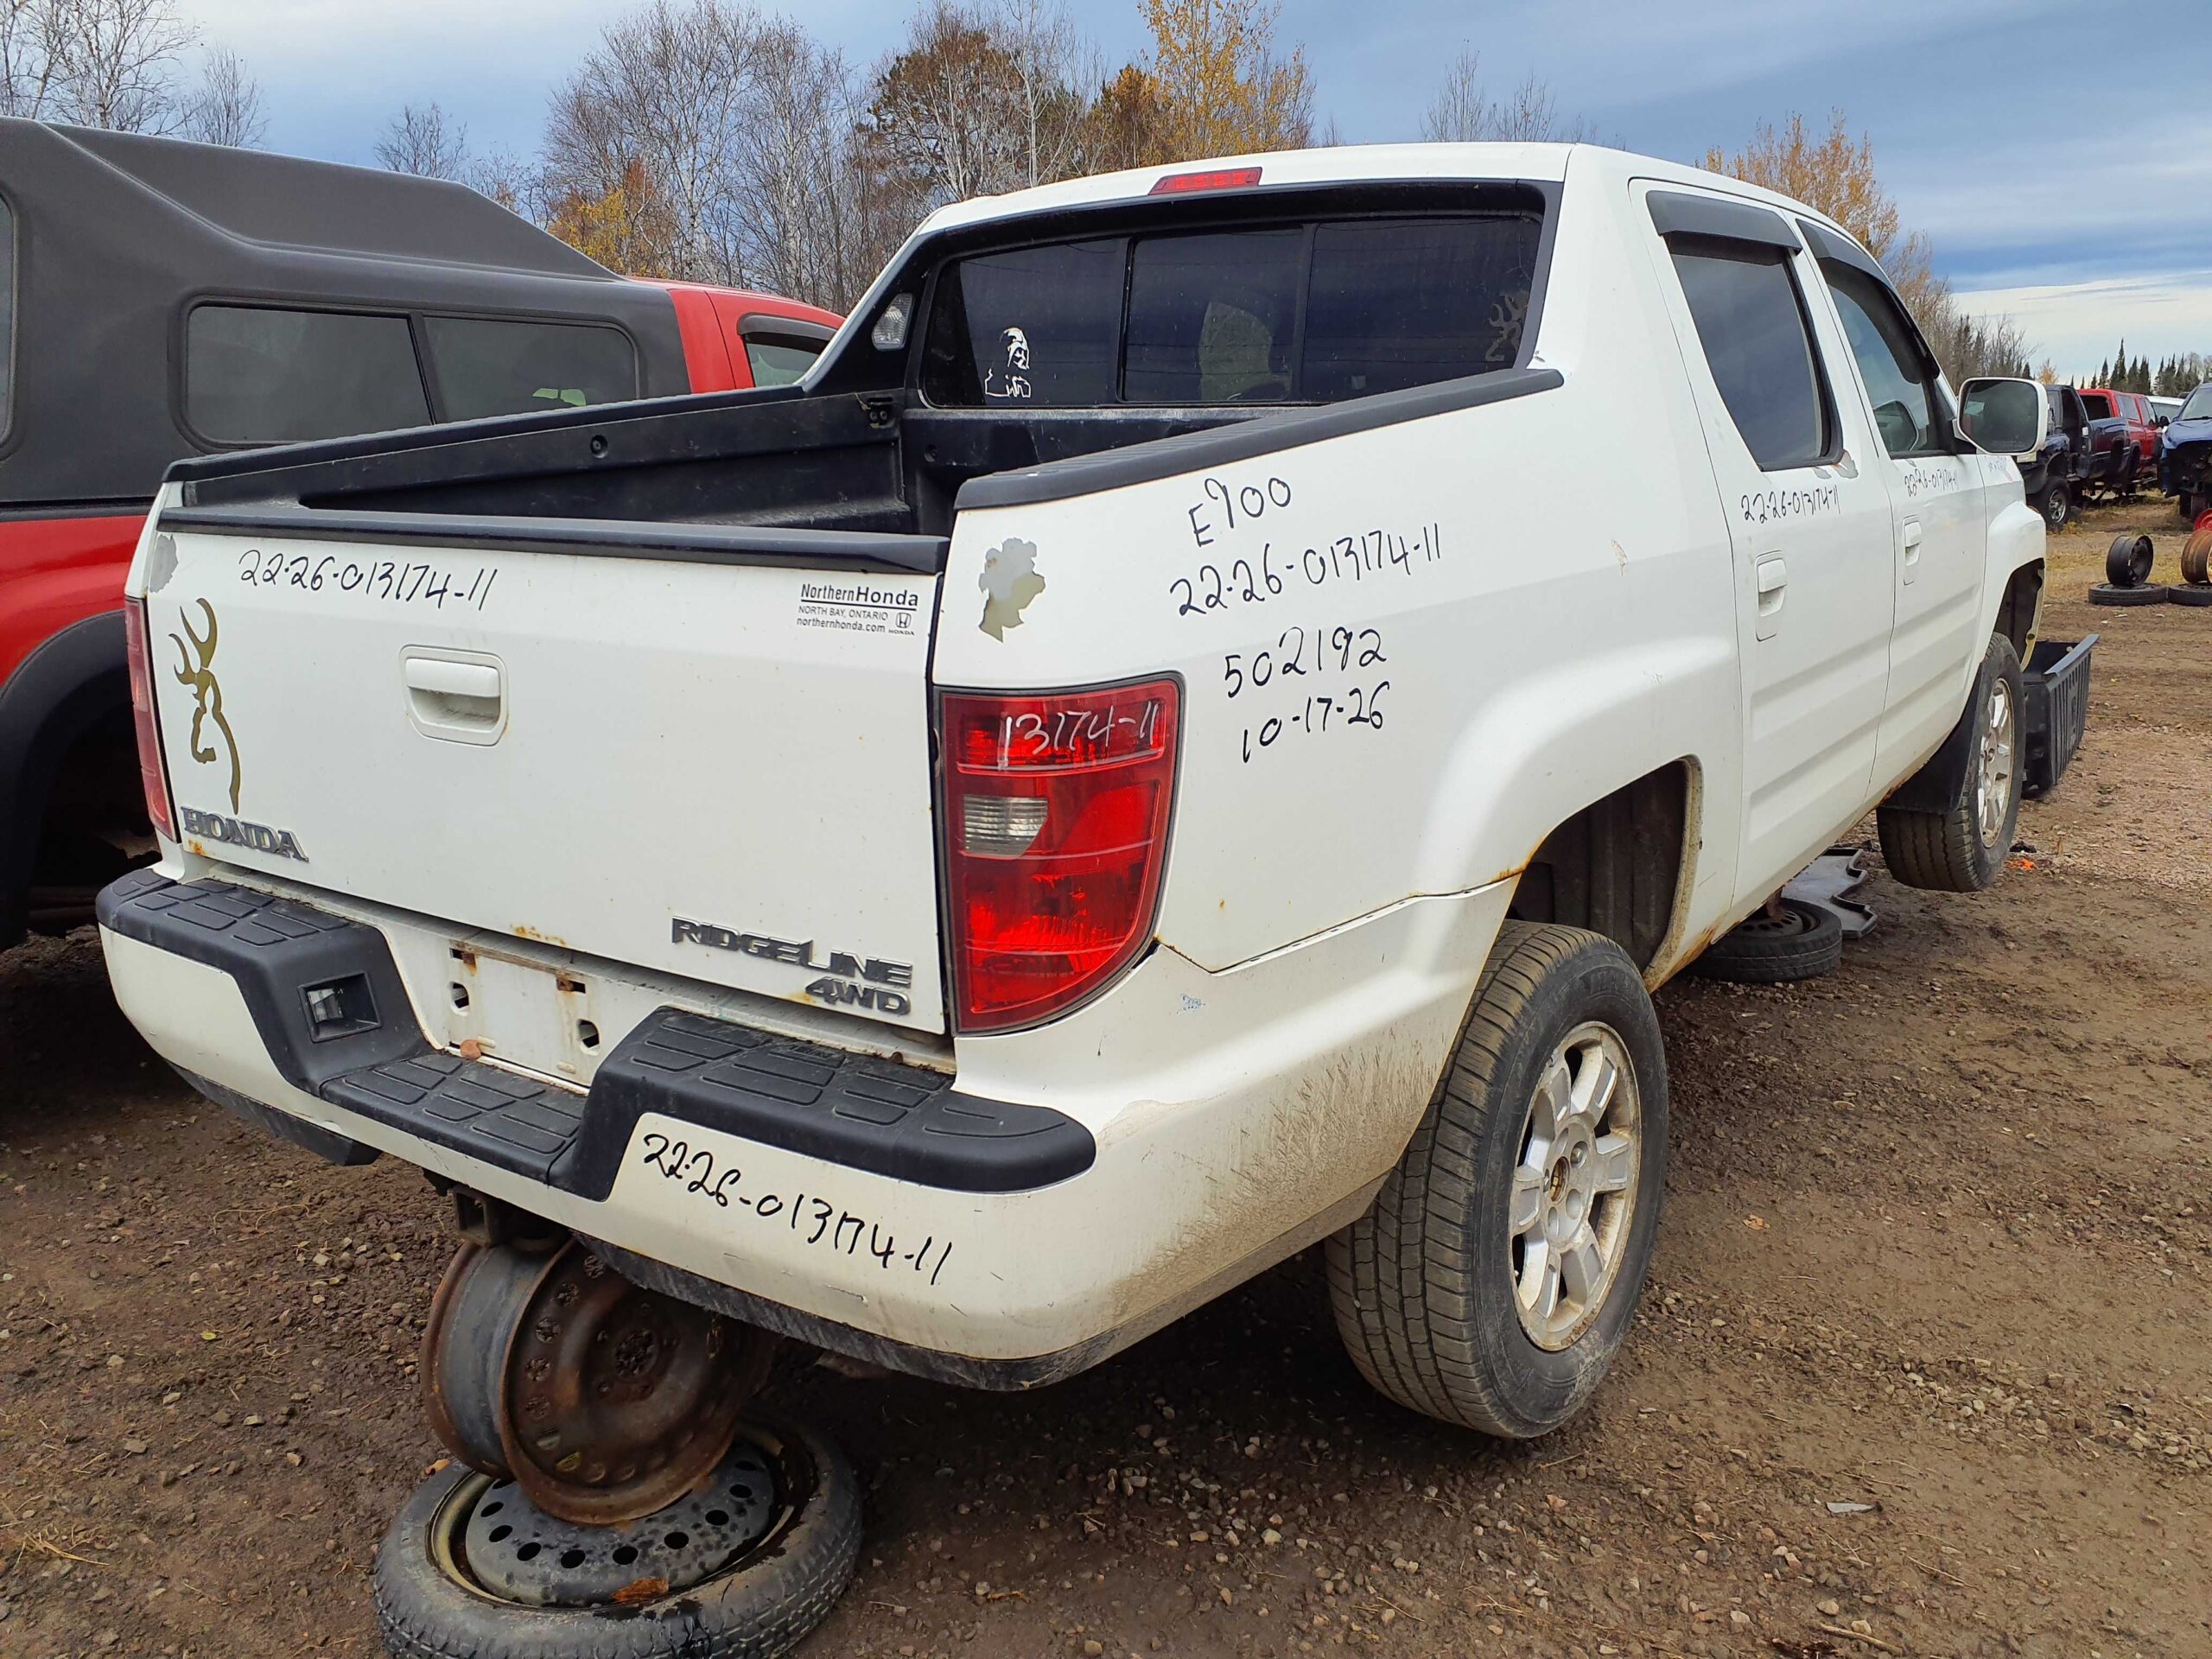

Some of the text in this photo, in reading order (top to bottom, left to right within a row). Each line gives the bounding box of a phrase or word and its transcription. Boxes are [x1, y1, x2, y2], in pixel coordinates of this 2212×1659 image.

[1189, 478, 1291, 547] E900
[797, 617, 886, 632] northernhonda.com
[798, 606, 888, 621] NORTH BAY, ONTARIO
[181, 806, 309, 863] HONDA
[671, 915, 912, 988] RIDGELINE
[805, 976, 911, 1015] 4WD
